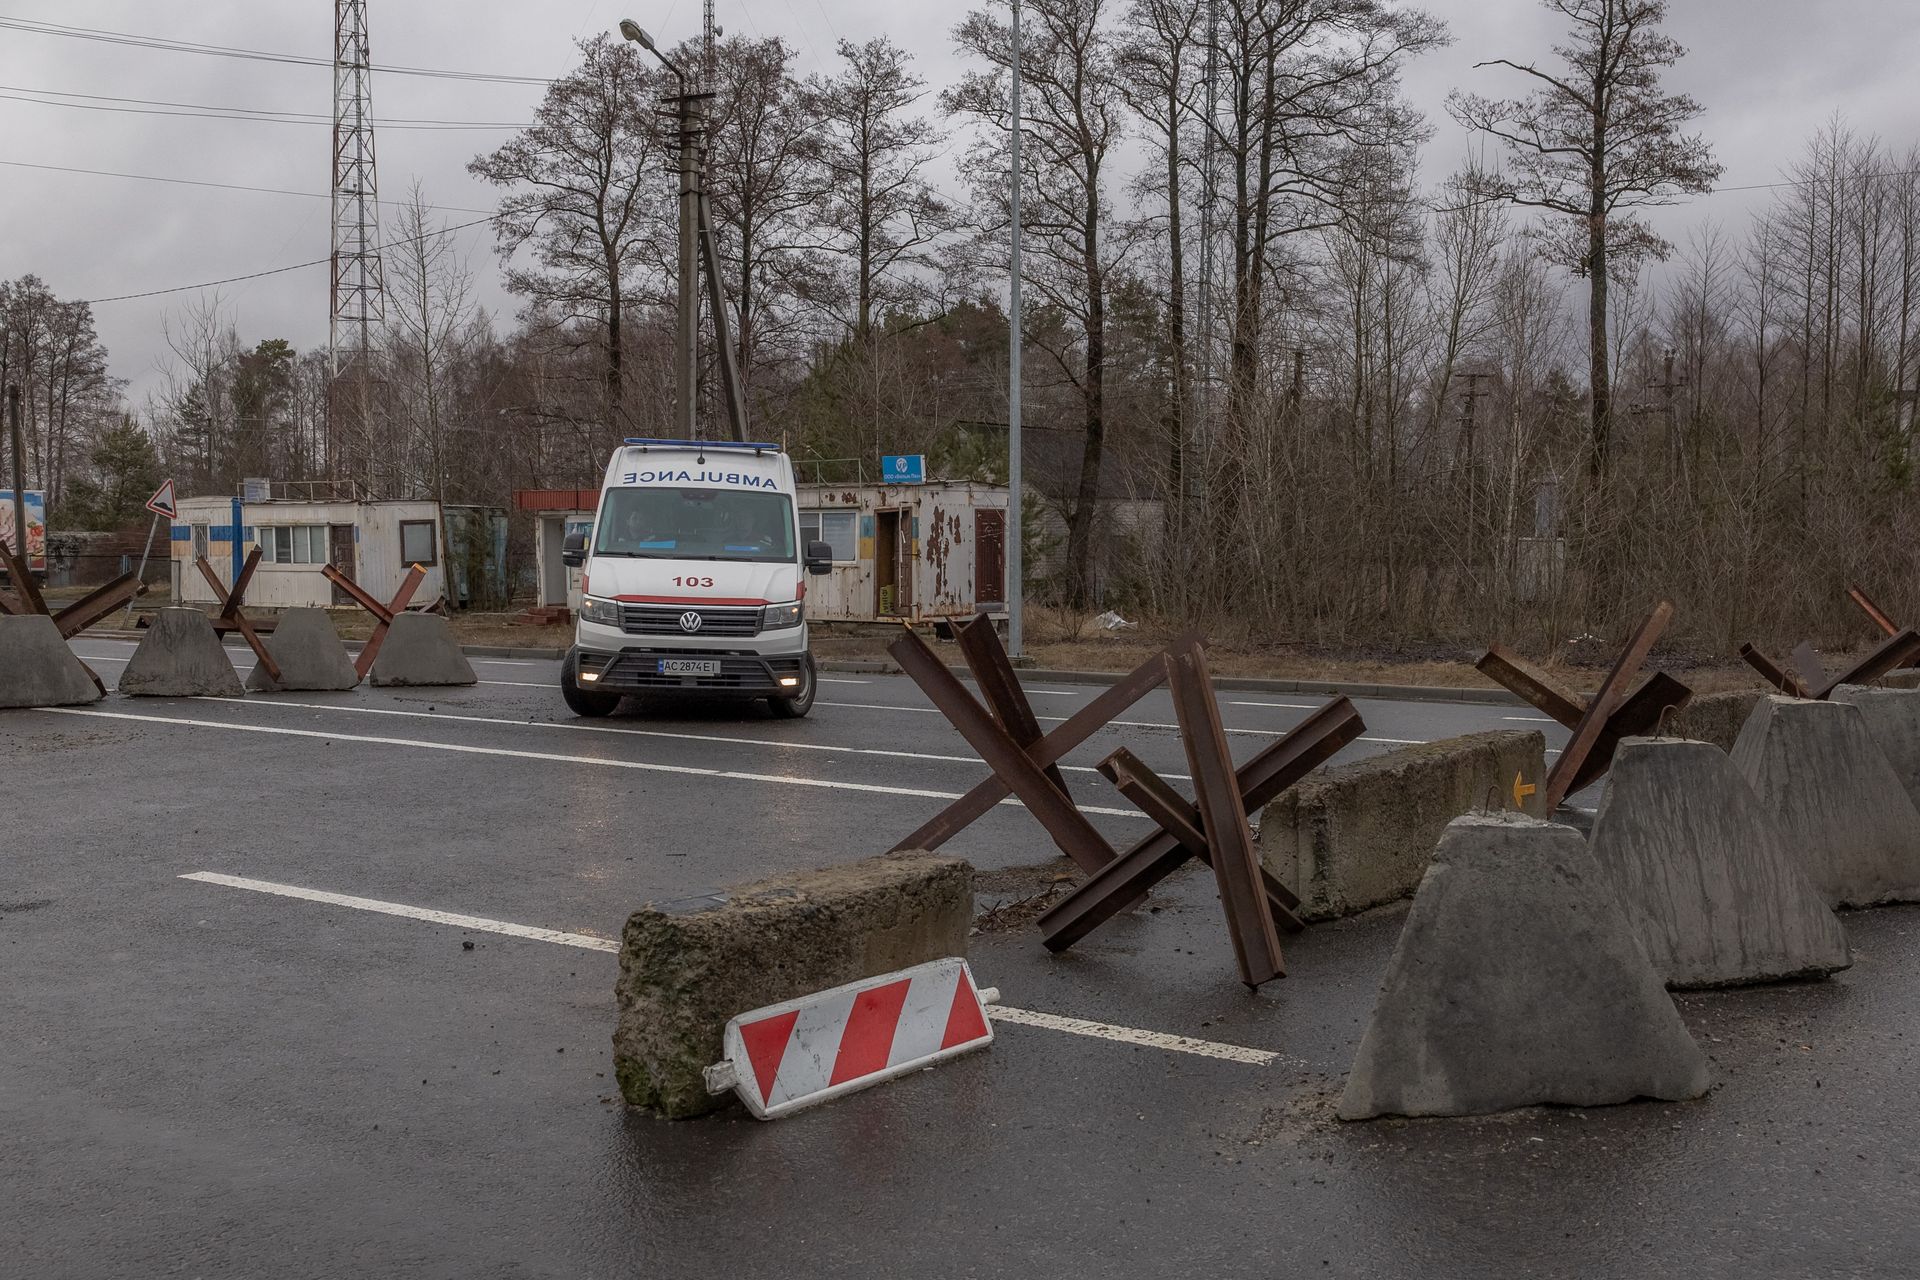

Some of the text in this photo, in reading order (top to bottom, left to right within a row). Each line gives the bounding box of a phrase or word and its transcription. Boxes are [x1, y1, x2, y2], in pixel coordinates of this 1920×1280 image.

[672, 576, 714, 588] 103
[664, 661, 678, 671] AC
[679, 661, 702, 672] 2874
